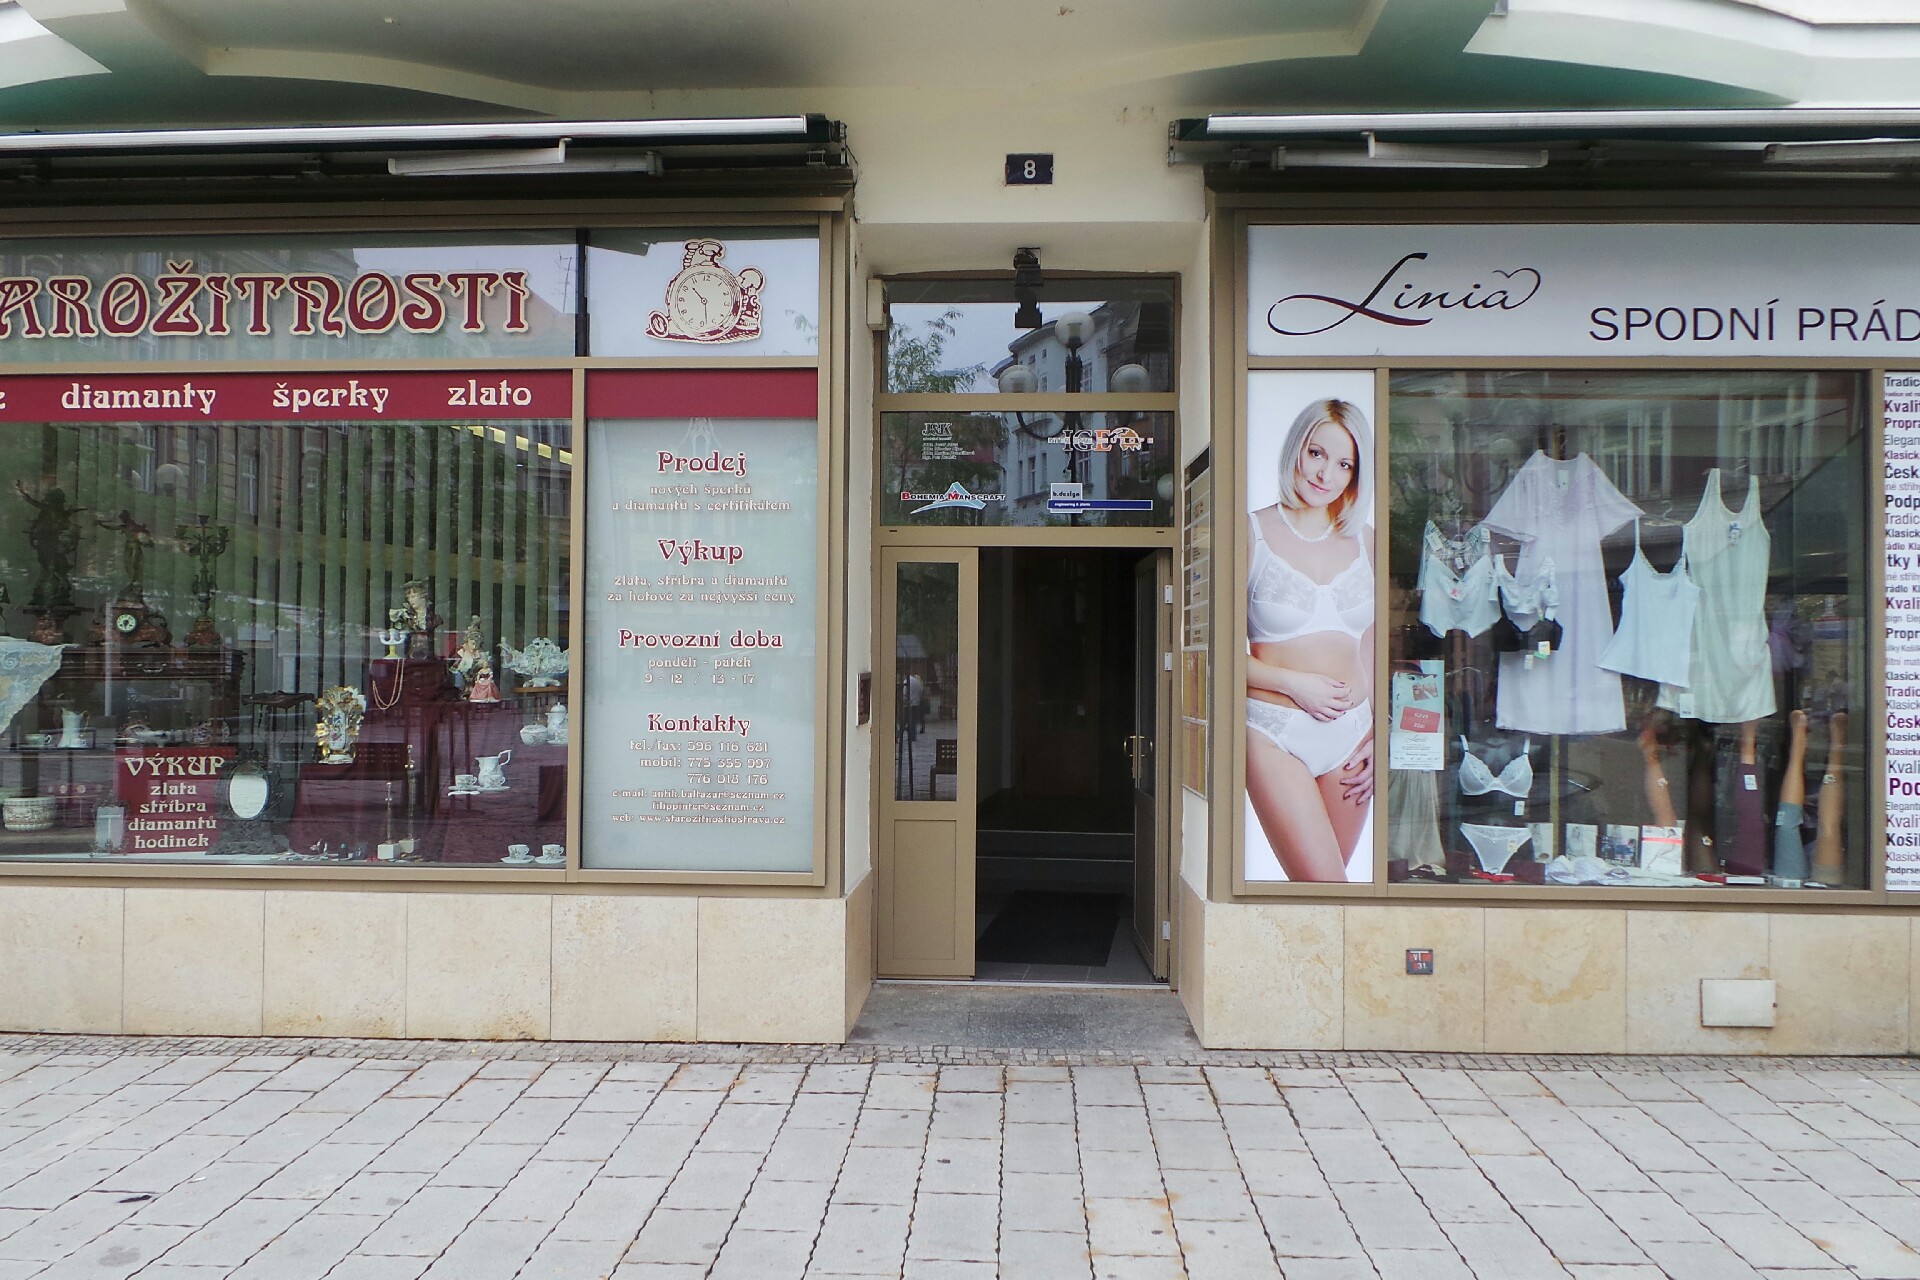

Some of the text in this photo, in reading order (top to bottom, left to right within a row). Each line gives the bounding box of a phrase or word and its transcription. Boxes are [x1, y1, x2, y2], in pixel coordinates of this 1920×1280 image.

[1024, 160, 1036, 179] 8
[1267, 252, 1541, 336] Linia
[1589, 298, 1920, 341] SPODNÍ PRÁD
[62, 380, 532, 414] diamanty šperky zlato
[657, 451, 747, 477] Prodej
[657, 539, 744, 566] Výkup
[1887, 554, 1910, 570] tky
[607, 593, 622, 601] za
[679, 593, 694, 601] za
[618, 629, 783, 648] Provozní doba
[644, 673, 653, 684] 9
[670, 673, 683, 684] 12
[742, 674, 755, 684] 17
[647, 714, 750, 737] Kontakty
[125, 753, 225, 776] VÝKUP
[640, 757, 681, 767] mobil:
[150, 782, 197, 795] zlata
[140, 800, 206, 814] stříbra
[128, 816, 217, 831] diamantů
[1885, 814, 1920, 828] Kvali
[134, 834, 209, 849] hodinek
